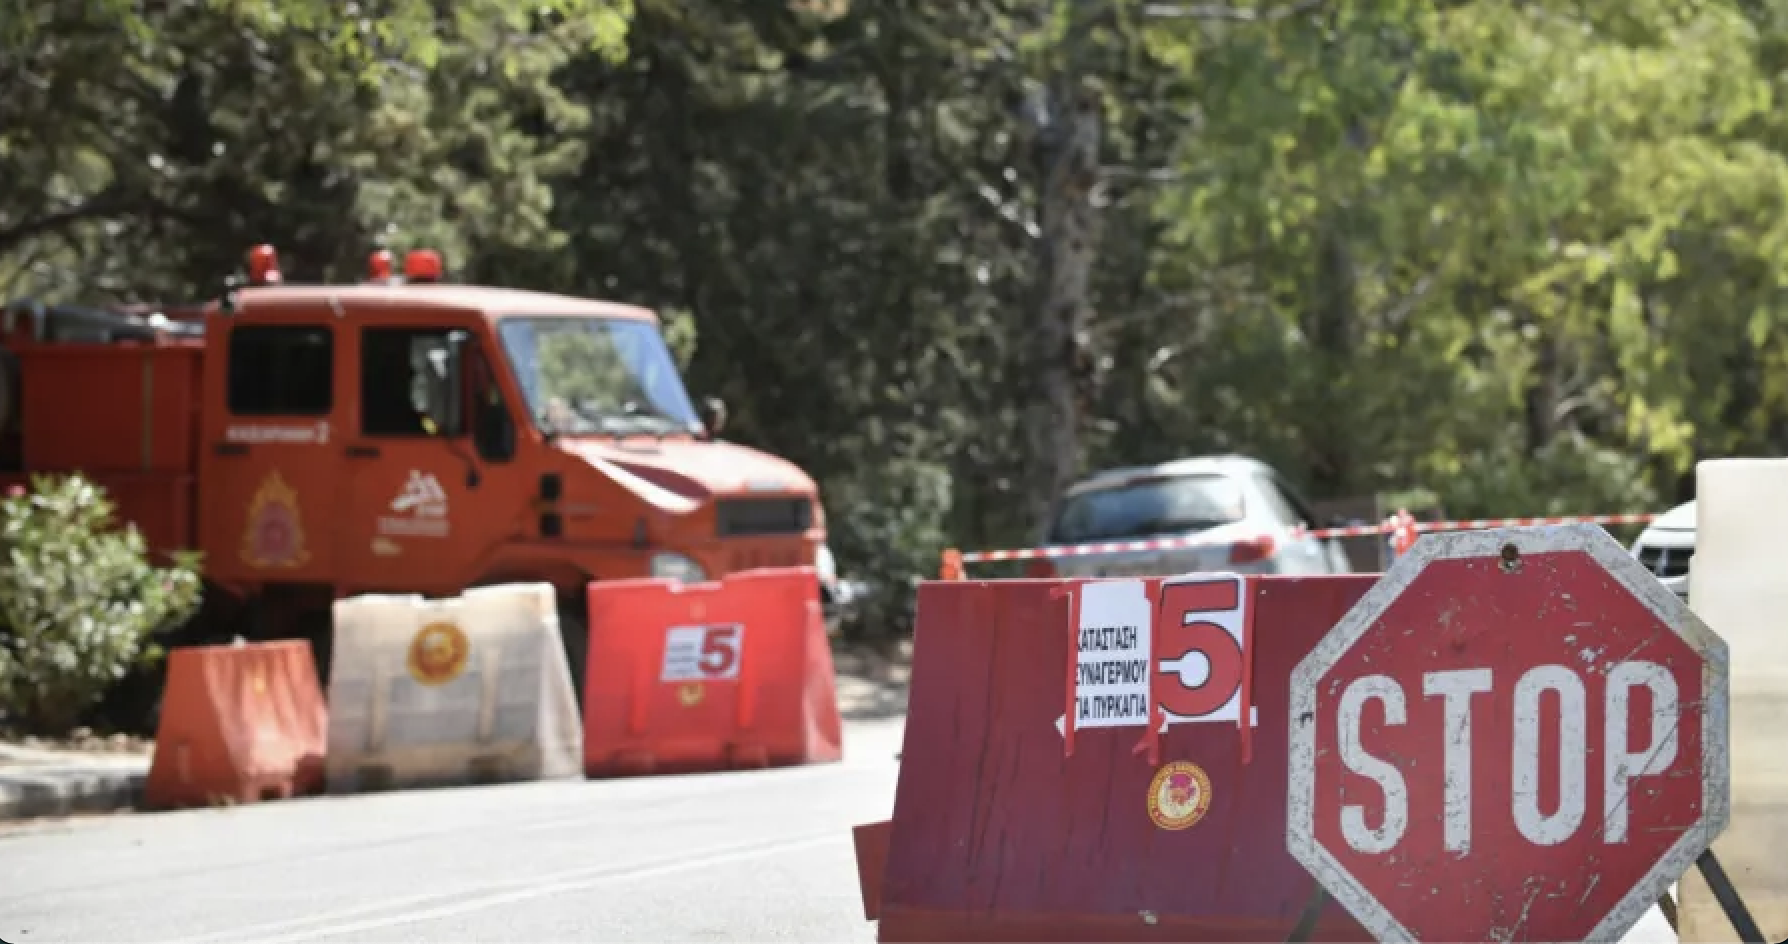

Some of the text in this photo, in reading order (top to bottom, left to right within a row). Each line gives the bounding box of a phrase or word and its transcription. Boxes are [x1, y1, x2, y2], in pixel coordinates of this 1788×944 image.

[698, 627, 735, 675] 5
[1157, 578, 1243, 717] 5
[1337, 660, 1679, 855] STOP
